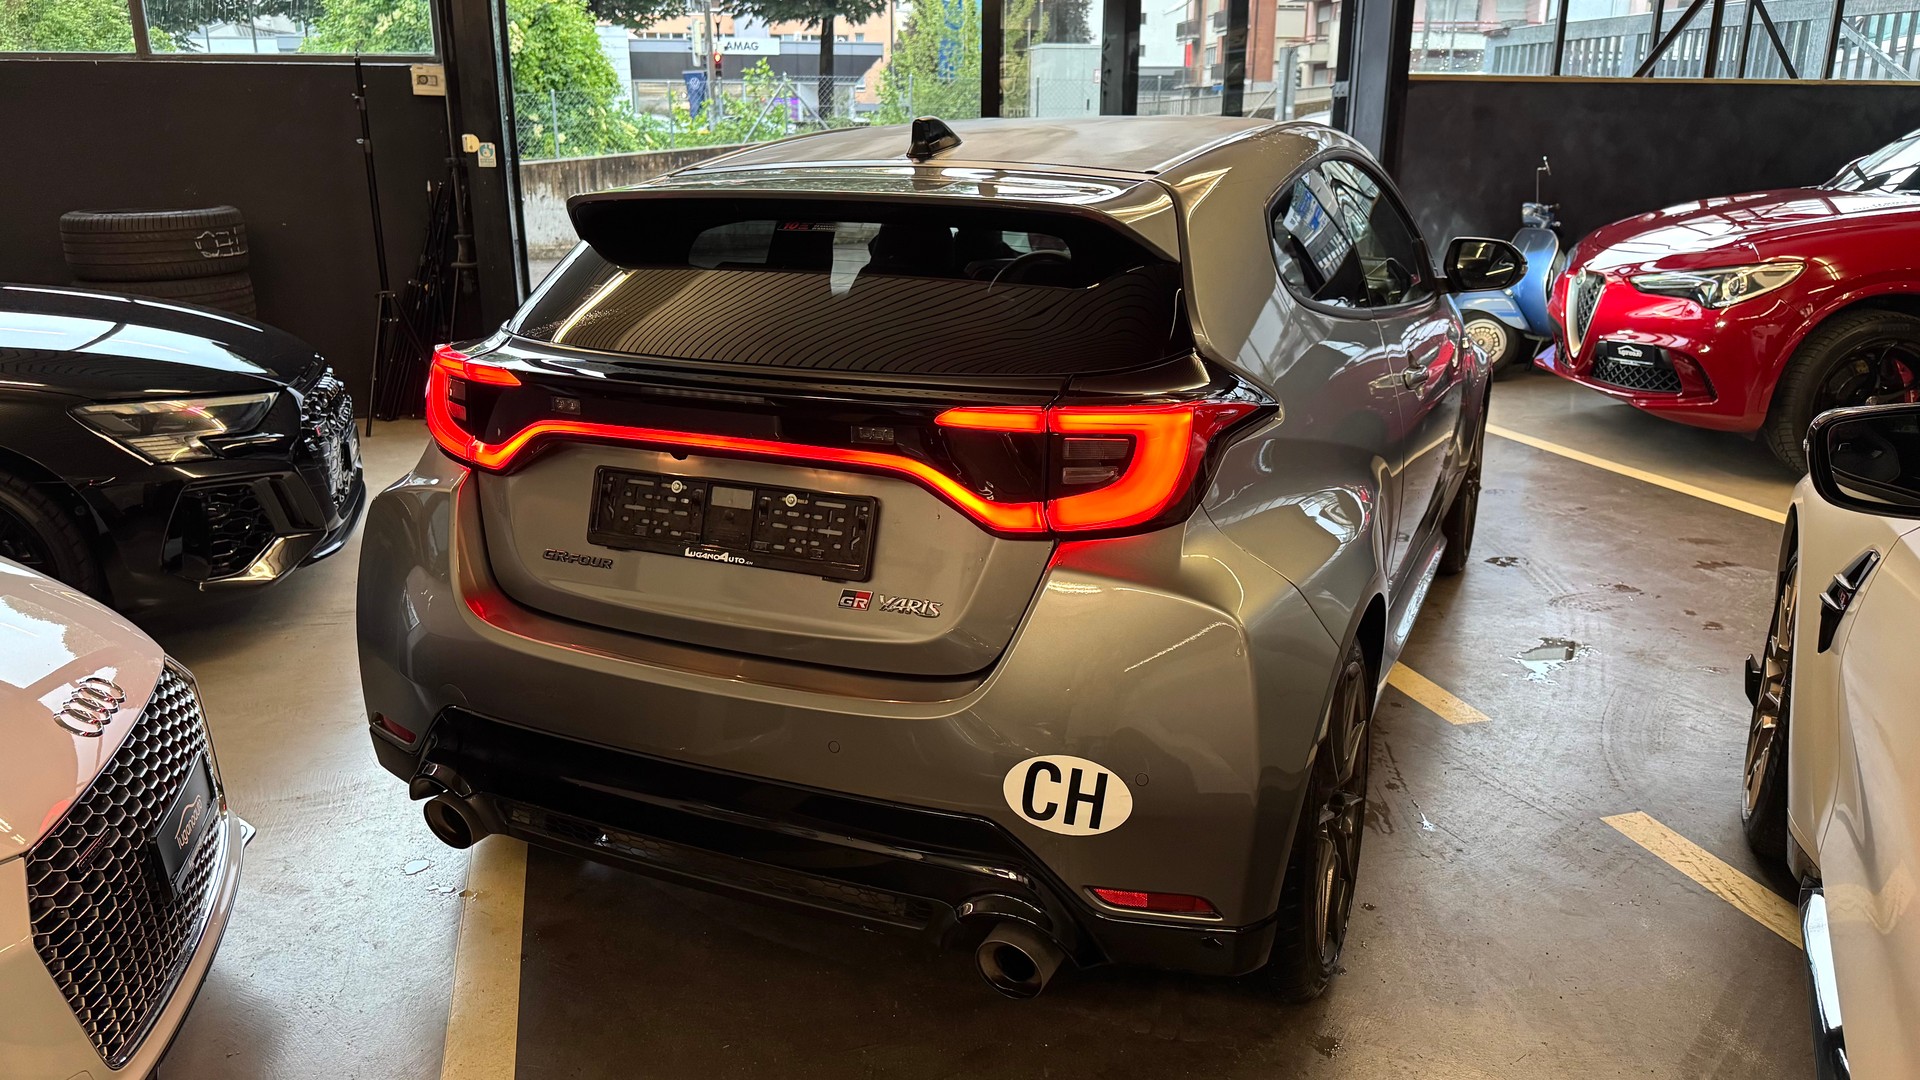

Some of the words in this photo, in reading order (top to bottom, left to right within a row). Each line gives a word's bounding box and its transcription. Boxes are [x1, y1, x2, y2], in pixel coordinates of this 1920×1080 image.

[726, 41, 760, 51] AMAG
[543, 548, 613, 569] GR-FOUR
[840, 596, 869, 609] GR
[879, 594, 943, 618] YARIS
[1022, 760, 1108, 830] CH
